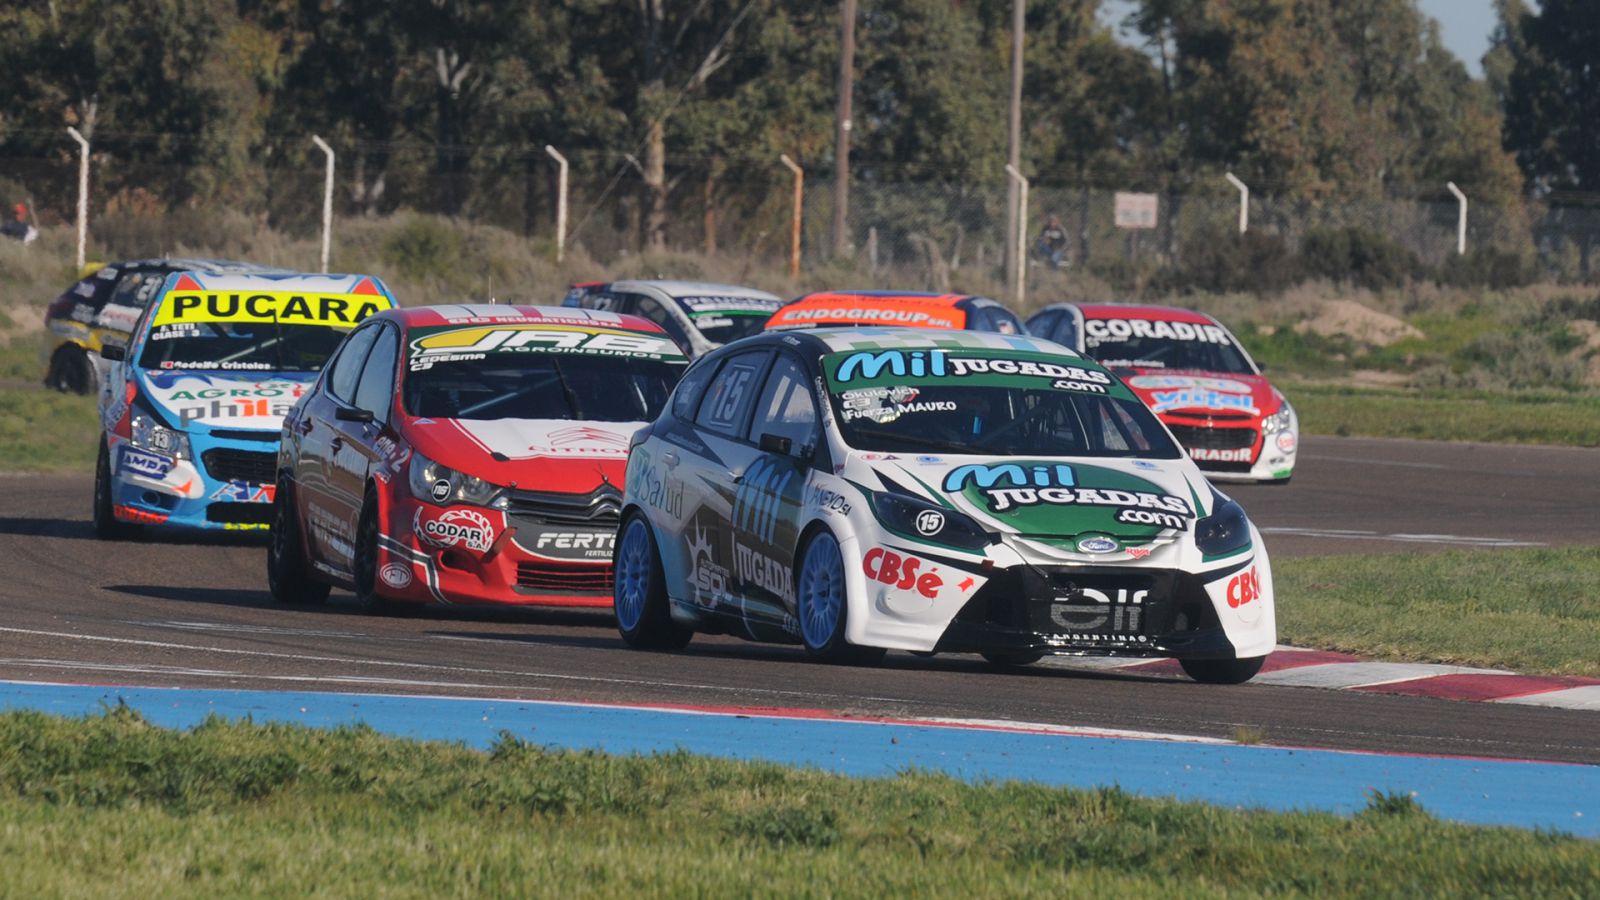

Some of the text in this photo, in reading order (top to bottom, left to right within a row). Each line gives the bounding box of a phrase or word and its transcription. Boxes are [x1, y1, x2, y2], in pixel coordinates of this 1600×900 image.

[173, 295, 380, 323] PUCARA
[783, 308, 929, 323] ENDOGROUP
[1085, 318, 1231, 346] CORADIR
[410, 353, 486, 365] LEDESMA
[499, 347, 662, 359] AGROINSUMOS
[838, 350, 946, 382] Mil
[949, 358, 1111, 386] JUGADAS
[168, 388, 284, 400] AGRO
[847, 401, 957, 420] Fuerza MAURO
[946, 463, 1076, 491] Mil
[641, 466, 685, 520] Salud
[987, 488, 1190, 515] JUGADAS
[427, 522, 481, 541] CODAR
[920, 513, 941, 531] 15
[736, 542, 798, 604] JUGADA
[863, 547, 944, 599] CBSé
